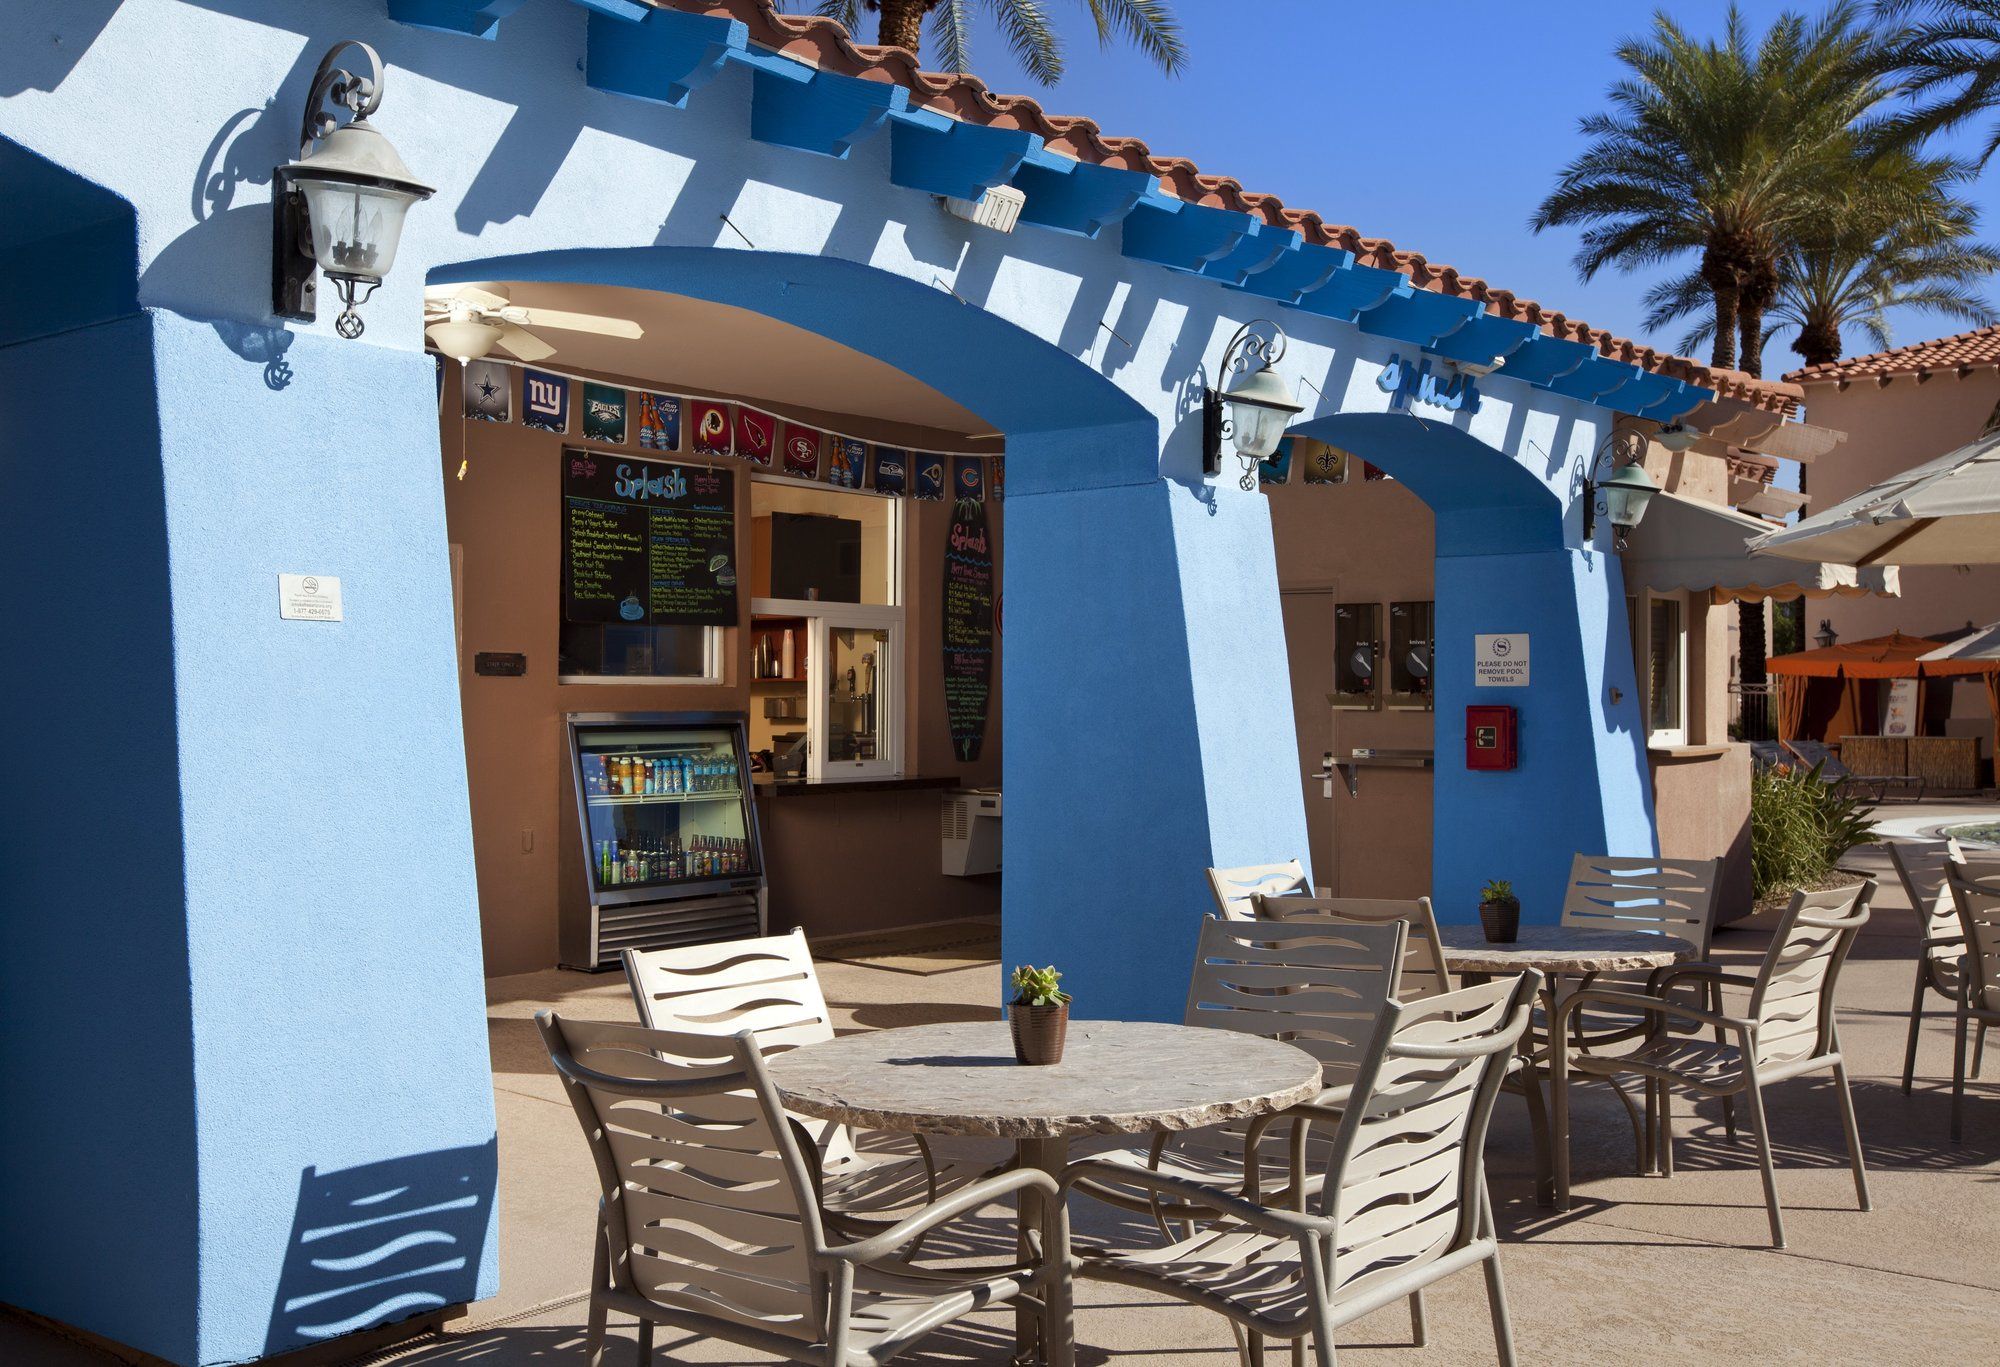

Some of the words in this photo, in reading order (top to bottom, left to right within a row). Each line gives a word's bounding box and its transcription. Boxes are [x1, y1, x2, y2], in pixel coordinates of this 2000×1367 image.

[591, 400, 621, 418] EAGLES
[614, 463, 688, 500] Splash
[951, 523, 988, 554] Splash
